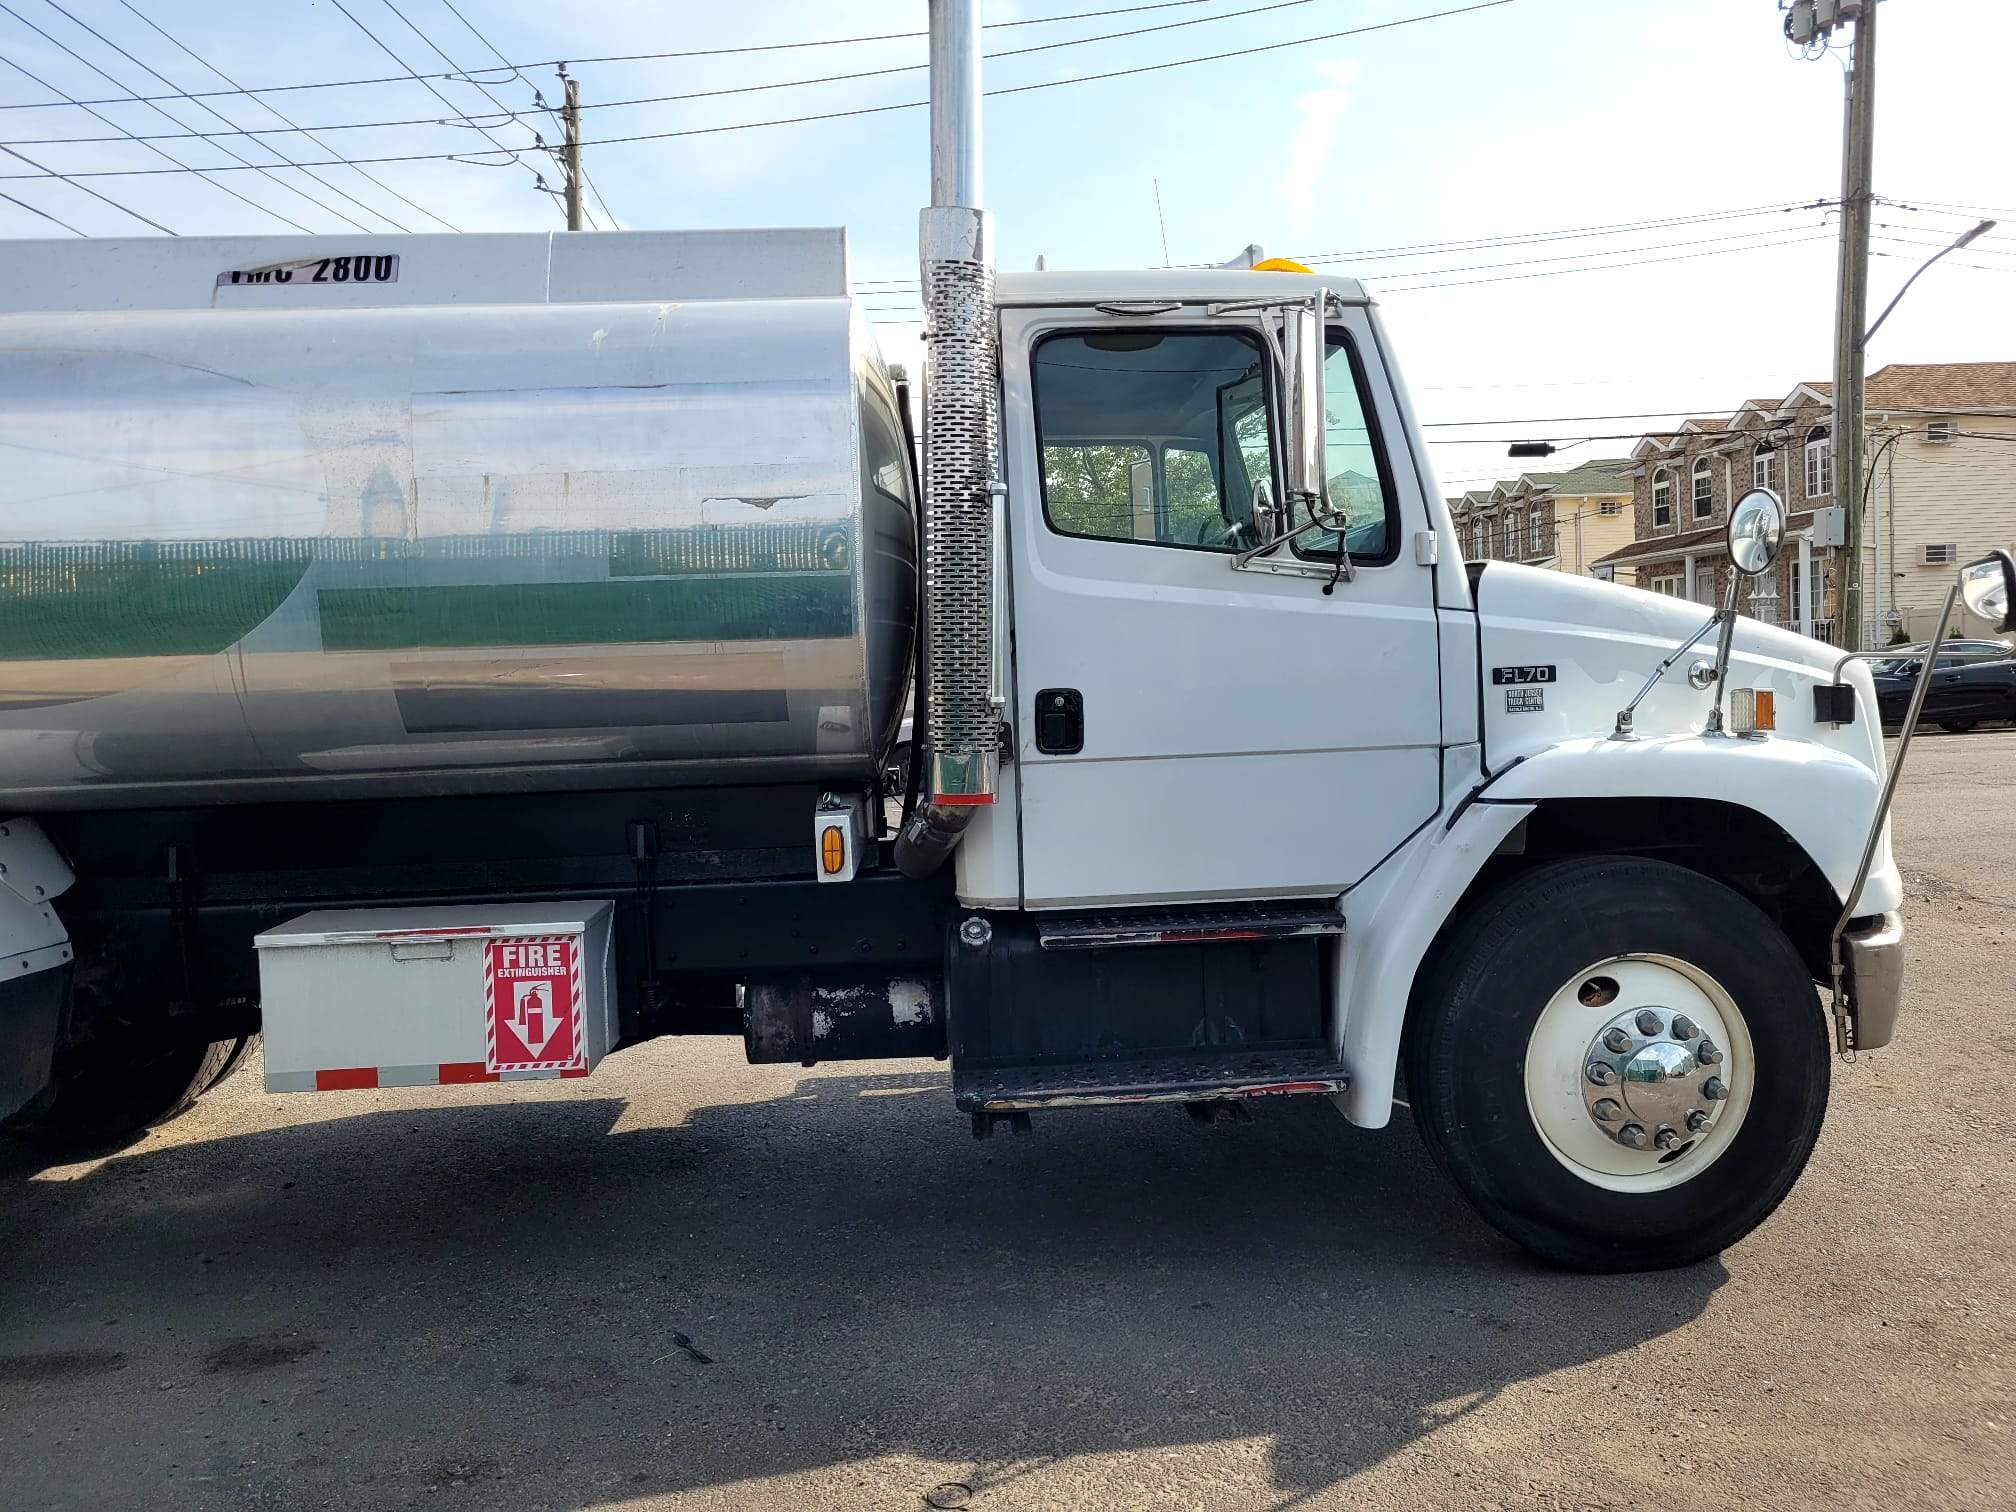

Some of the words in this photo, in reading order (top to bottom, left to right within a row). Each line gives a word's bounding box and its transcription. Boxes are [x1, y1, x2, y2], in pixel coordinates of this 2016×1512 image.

[312, 256, 393, 282] 2800
[1502, 667, 1548, 682] FL70
[502, 945, 562, 968] FIRE
[497, 967, 567, 977] EXTINGUISHER
